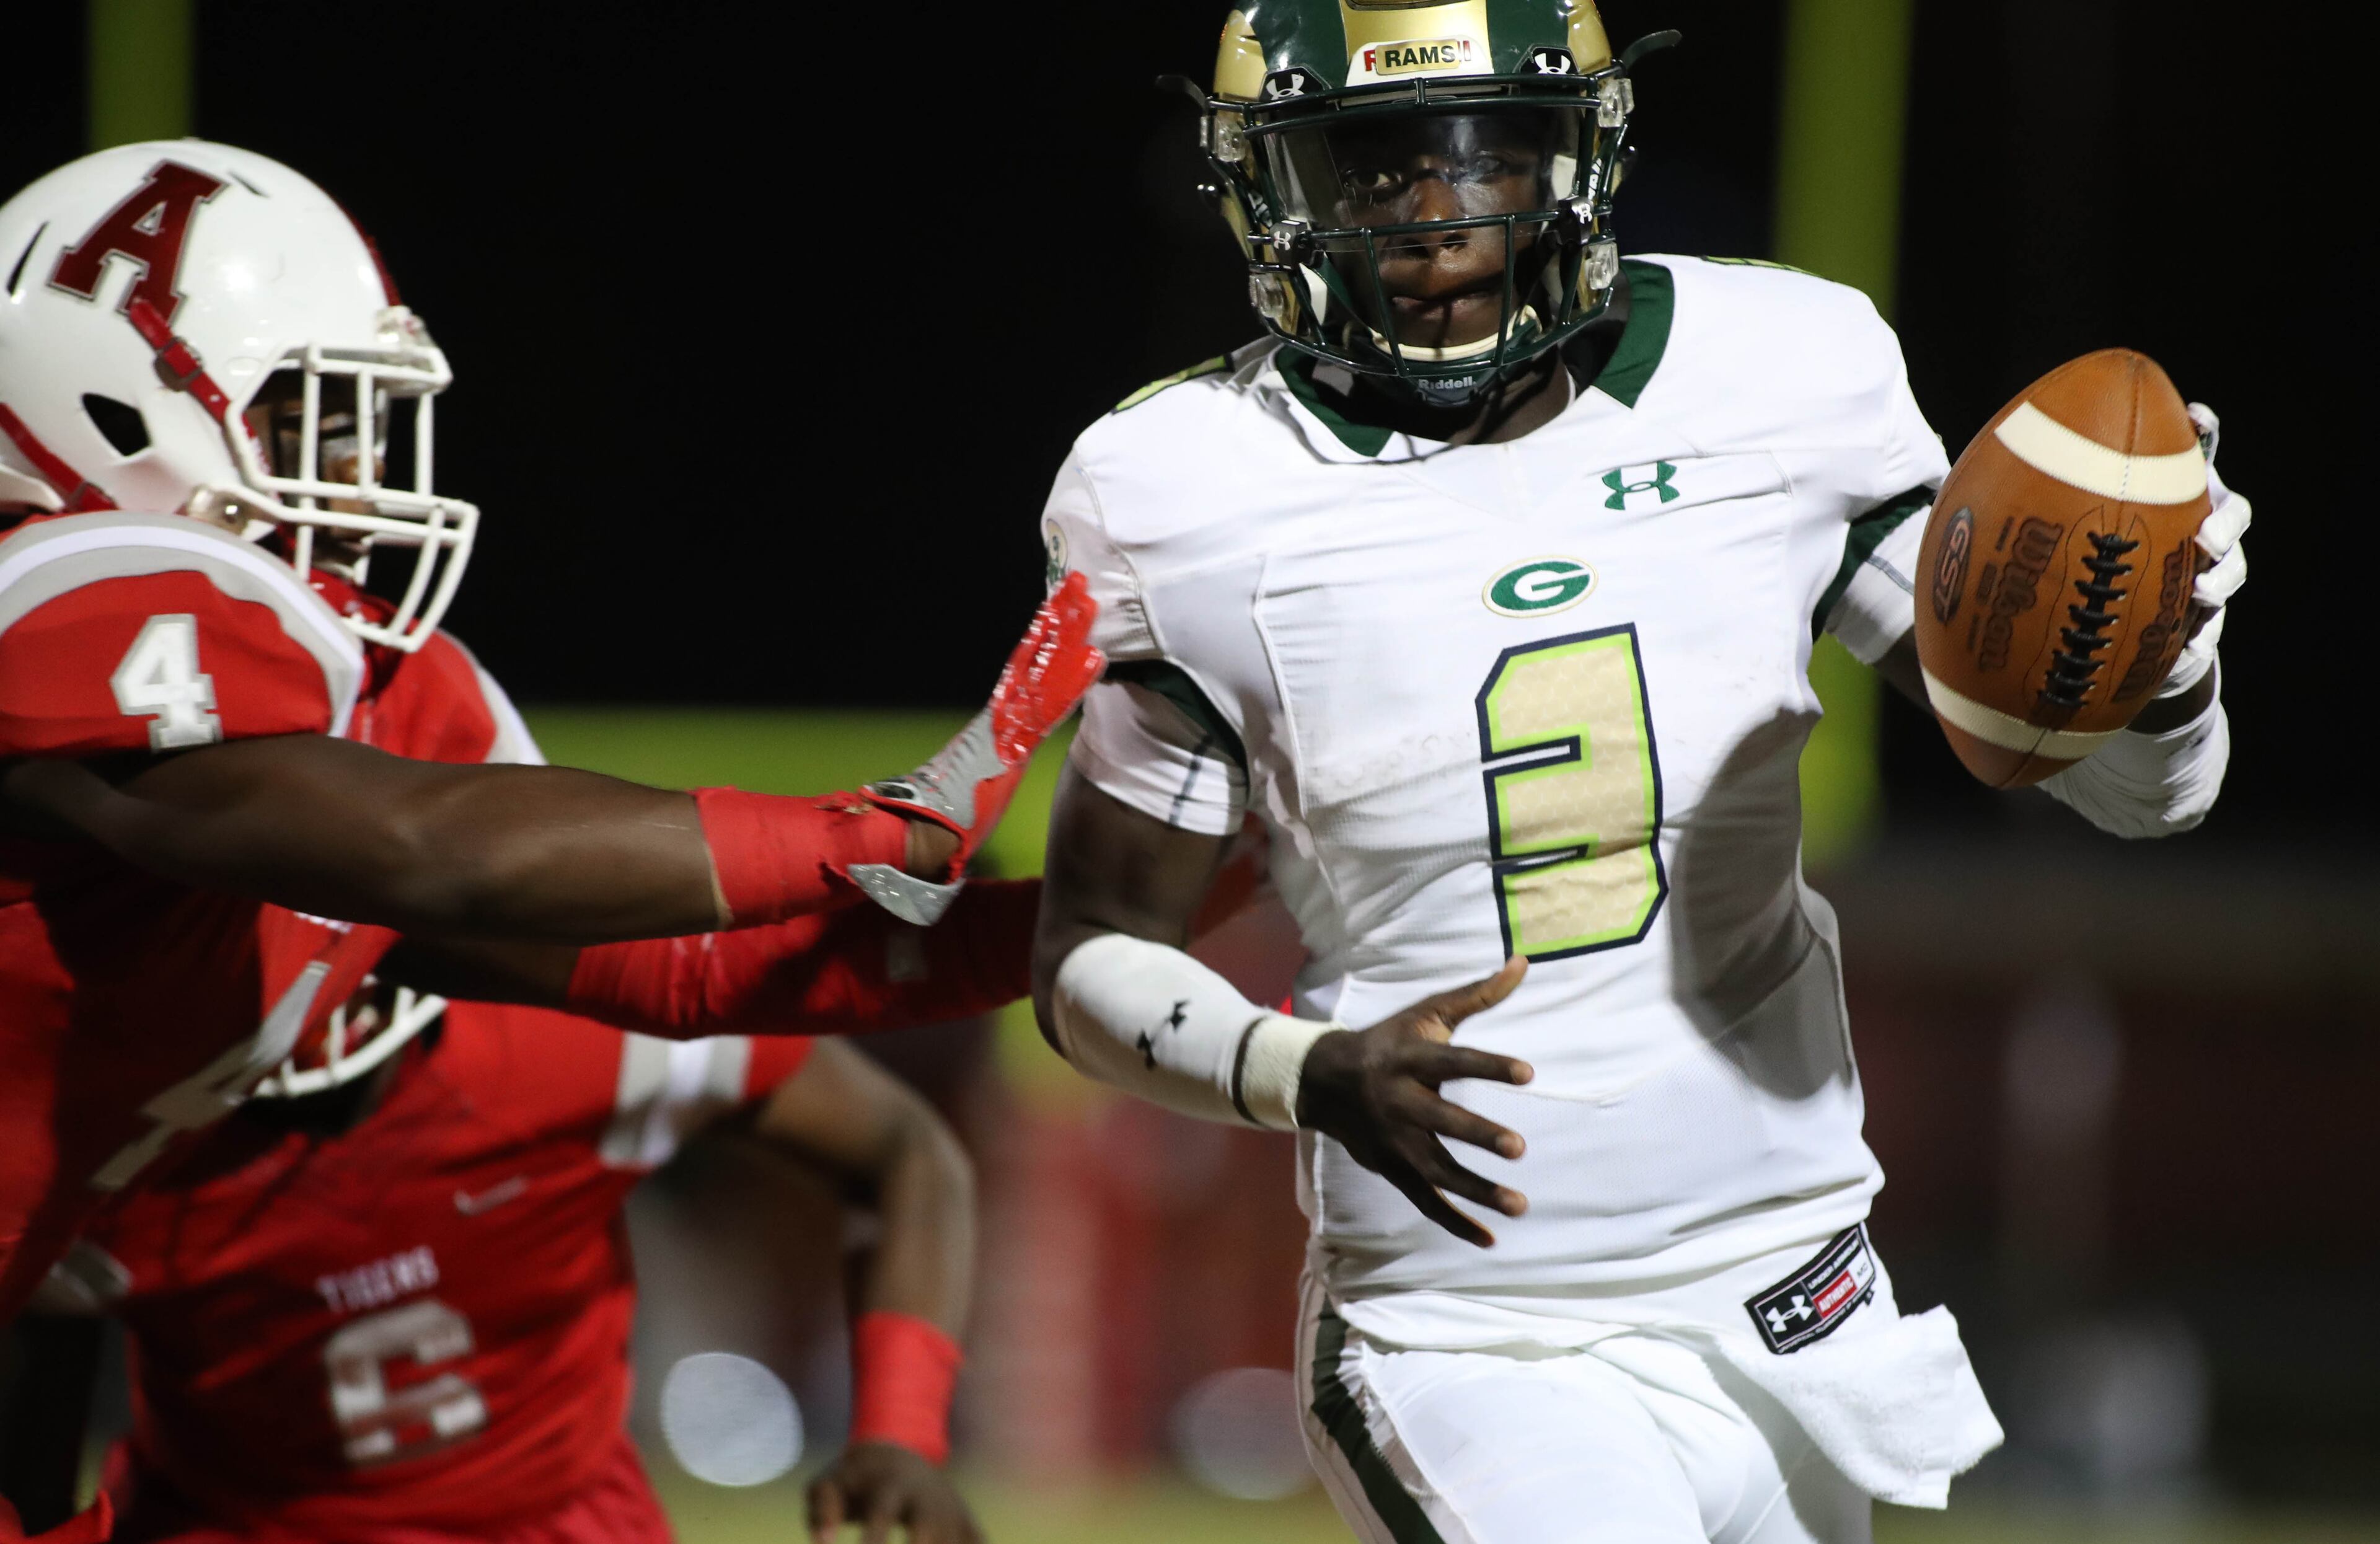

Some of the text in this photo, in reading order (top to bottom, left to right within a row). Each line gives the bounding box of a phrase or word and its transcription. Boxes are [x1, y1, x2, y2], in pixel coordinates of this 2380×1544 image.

[1385, 45, 1456, 68] RAMS
[47, 158, 230, 326] A
[1418, 376, 1476, 390] Riddell
[1491, 561, 1590, 611] G
[108, 612, 224, 752] 4
[1475, 622, 1668, 963] 3
[1818, 1277, 1854, 1312] AUTHENTIC
